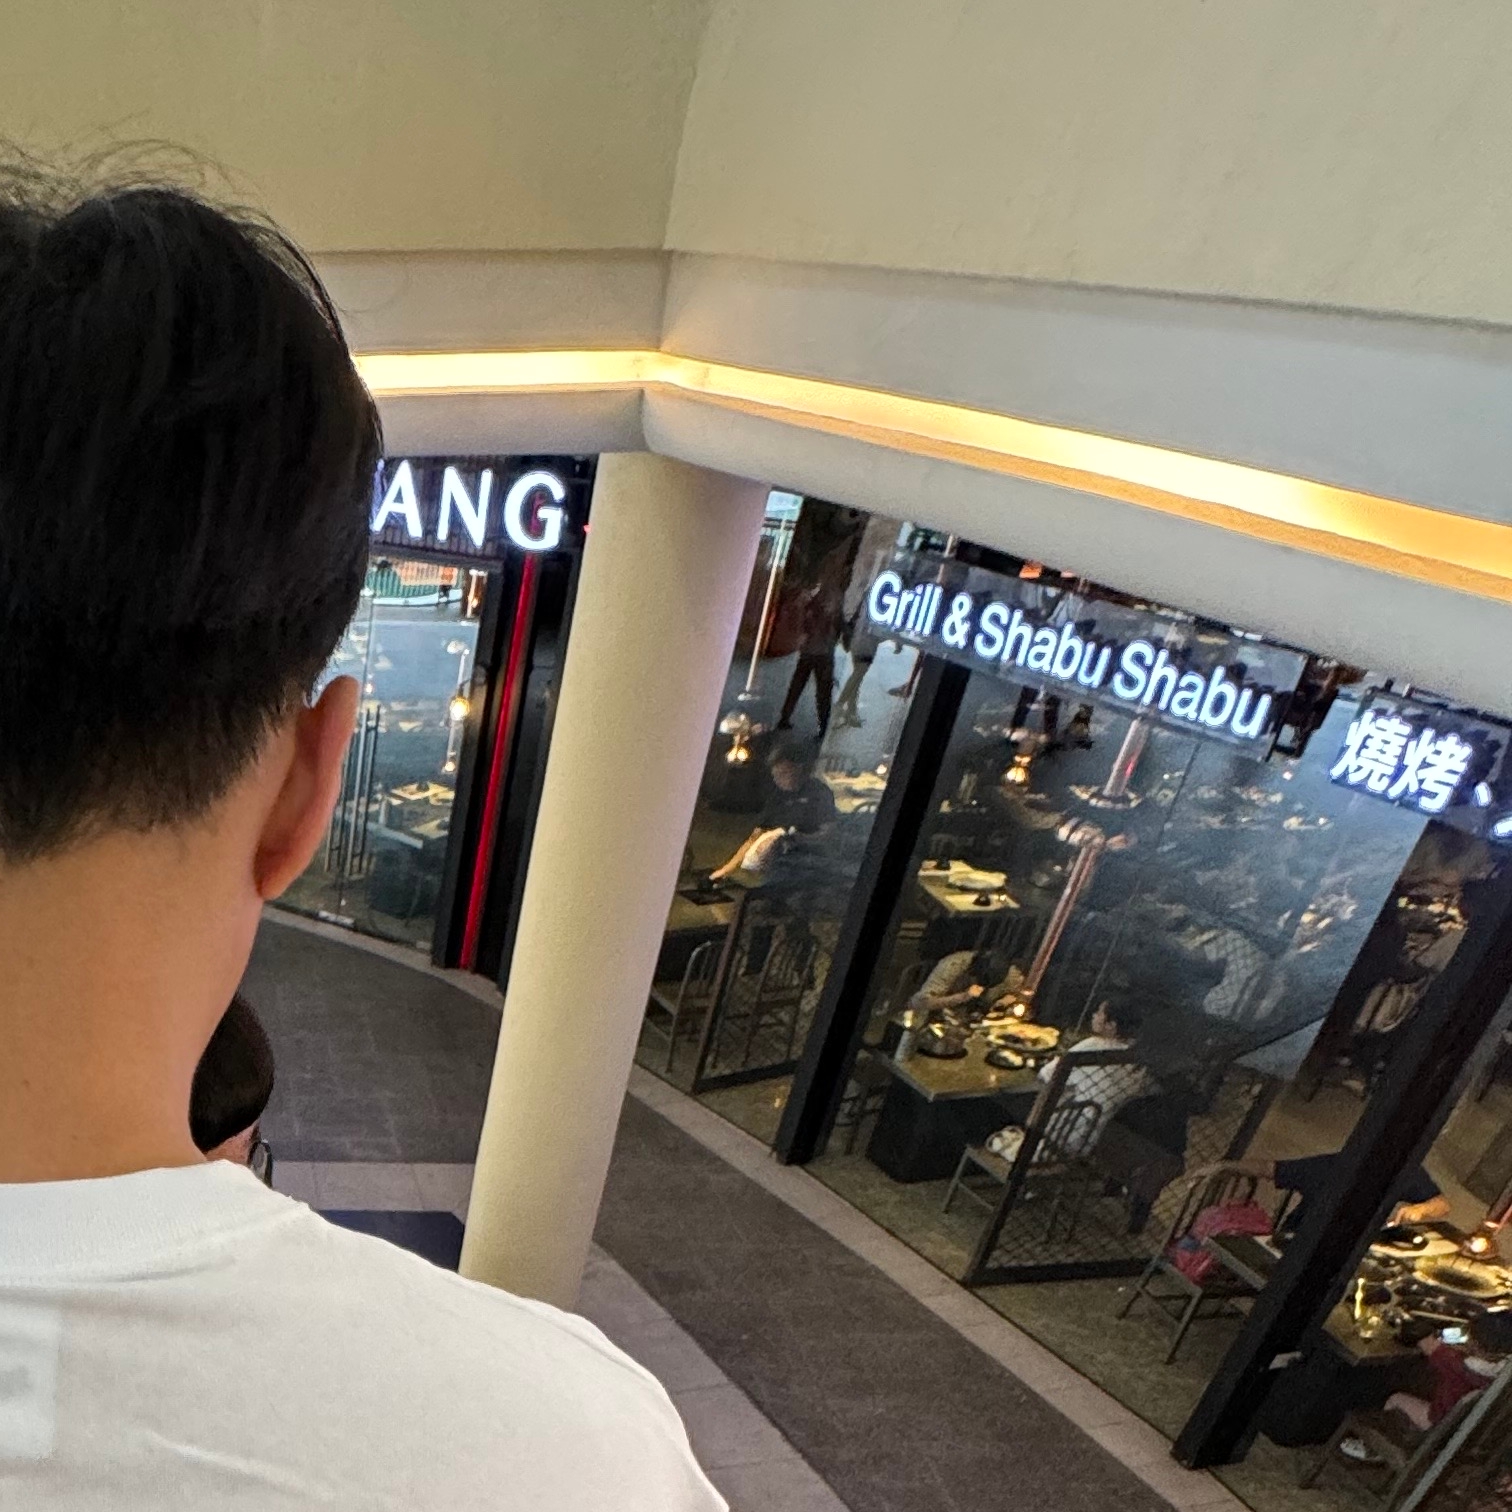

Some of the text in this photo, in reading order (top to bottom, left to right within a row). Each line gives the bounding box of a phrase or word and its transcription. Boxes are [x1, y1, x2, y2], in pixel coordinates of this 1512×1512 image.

[371, 459, 566, 550] ANG
[867, 570, 1272, 738] Grill & Shabu Shabu
